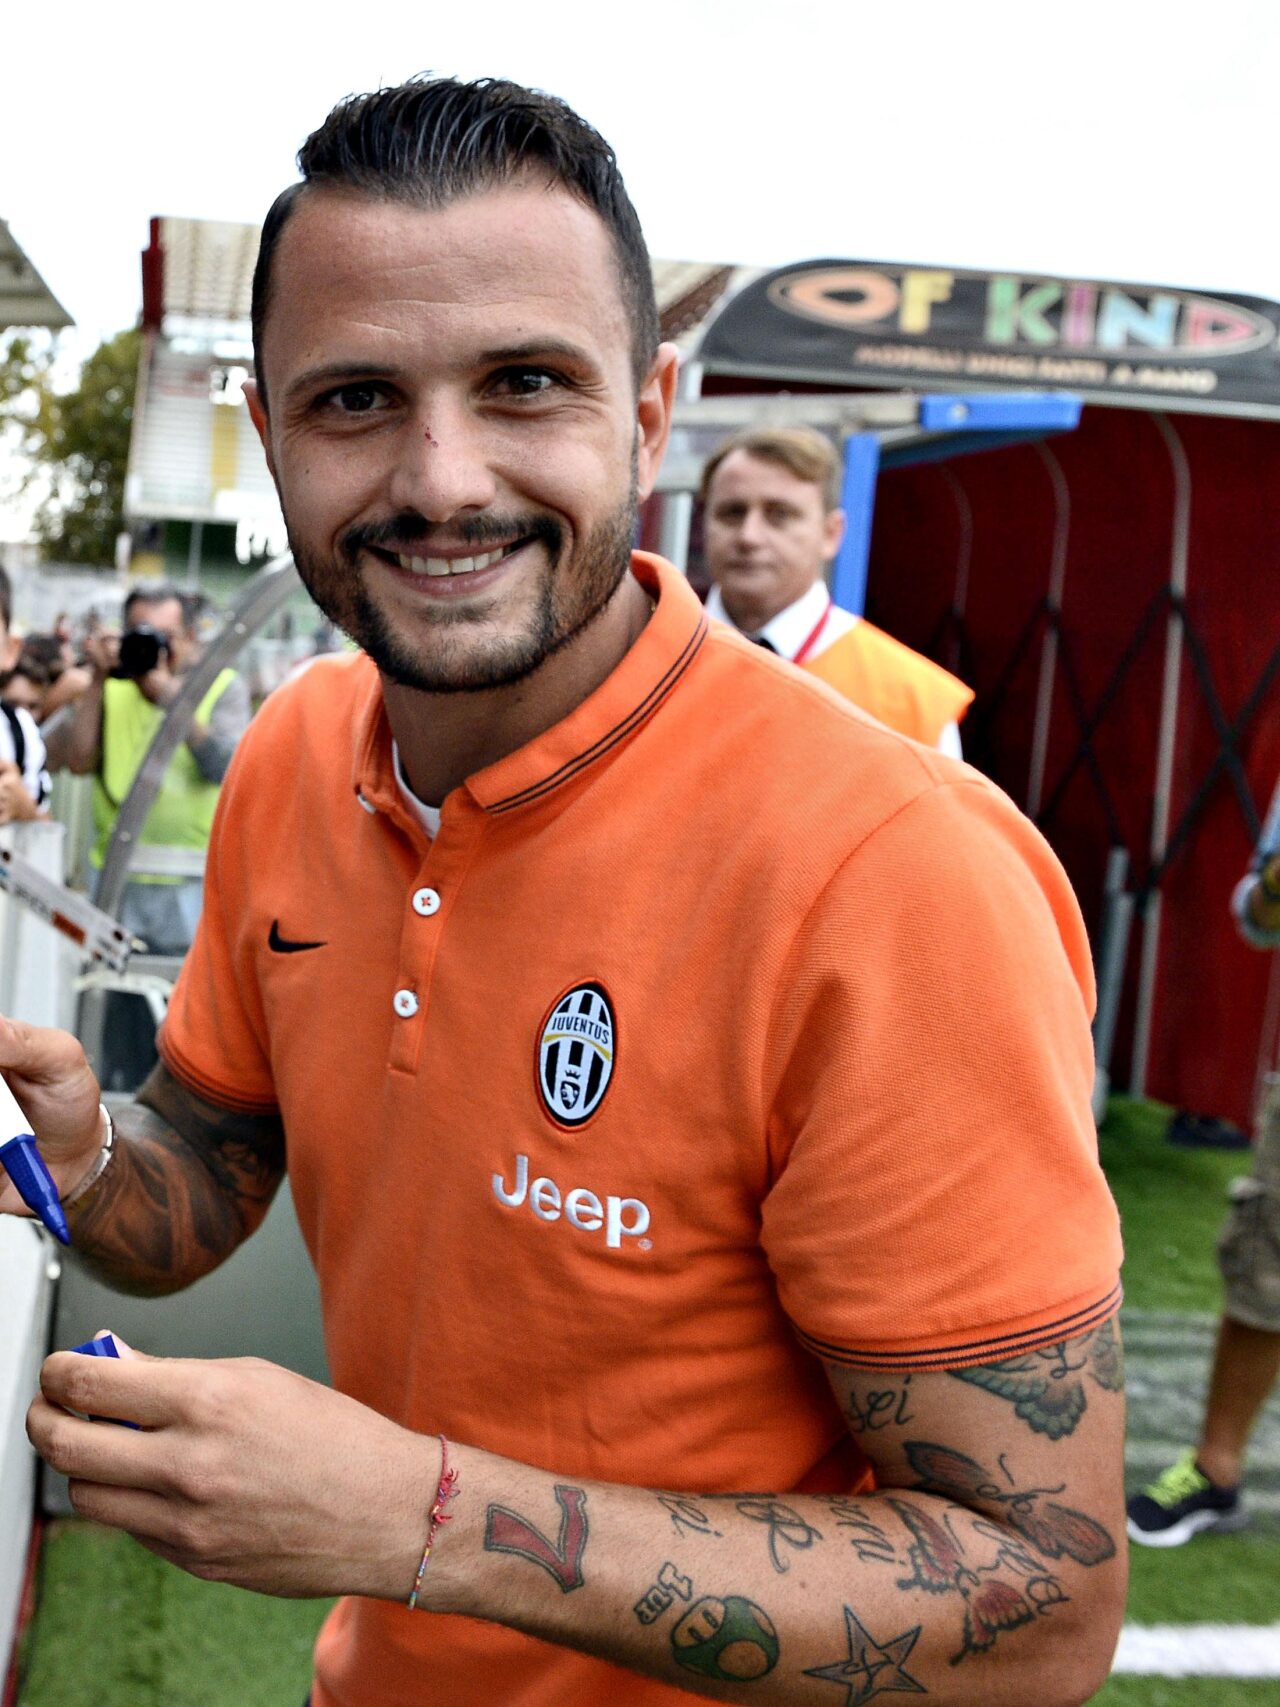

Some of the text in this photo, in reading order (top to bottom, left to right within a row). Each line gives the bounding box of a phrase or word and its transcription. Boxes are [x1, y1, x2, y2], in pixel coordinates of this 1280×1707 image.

[786, 271, 1257, 350] OF KIND
[551, 1015, 610, 1045] JUVENTUS
[491, 1154, 651, 1249] Jeep
